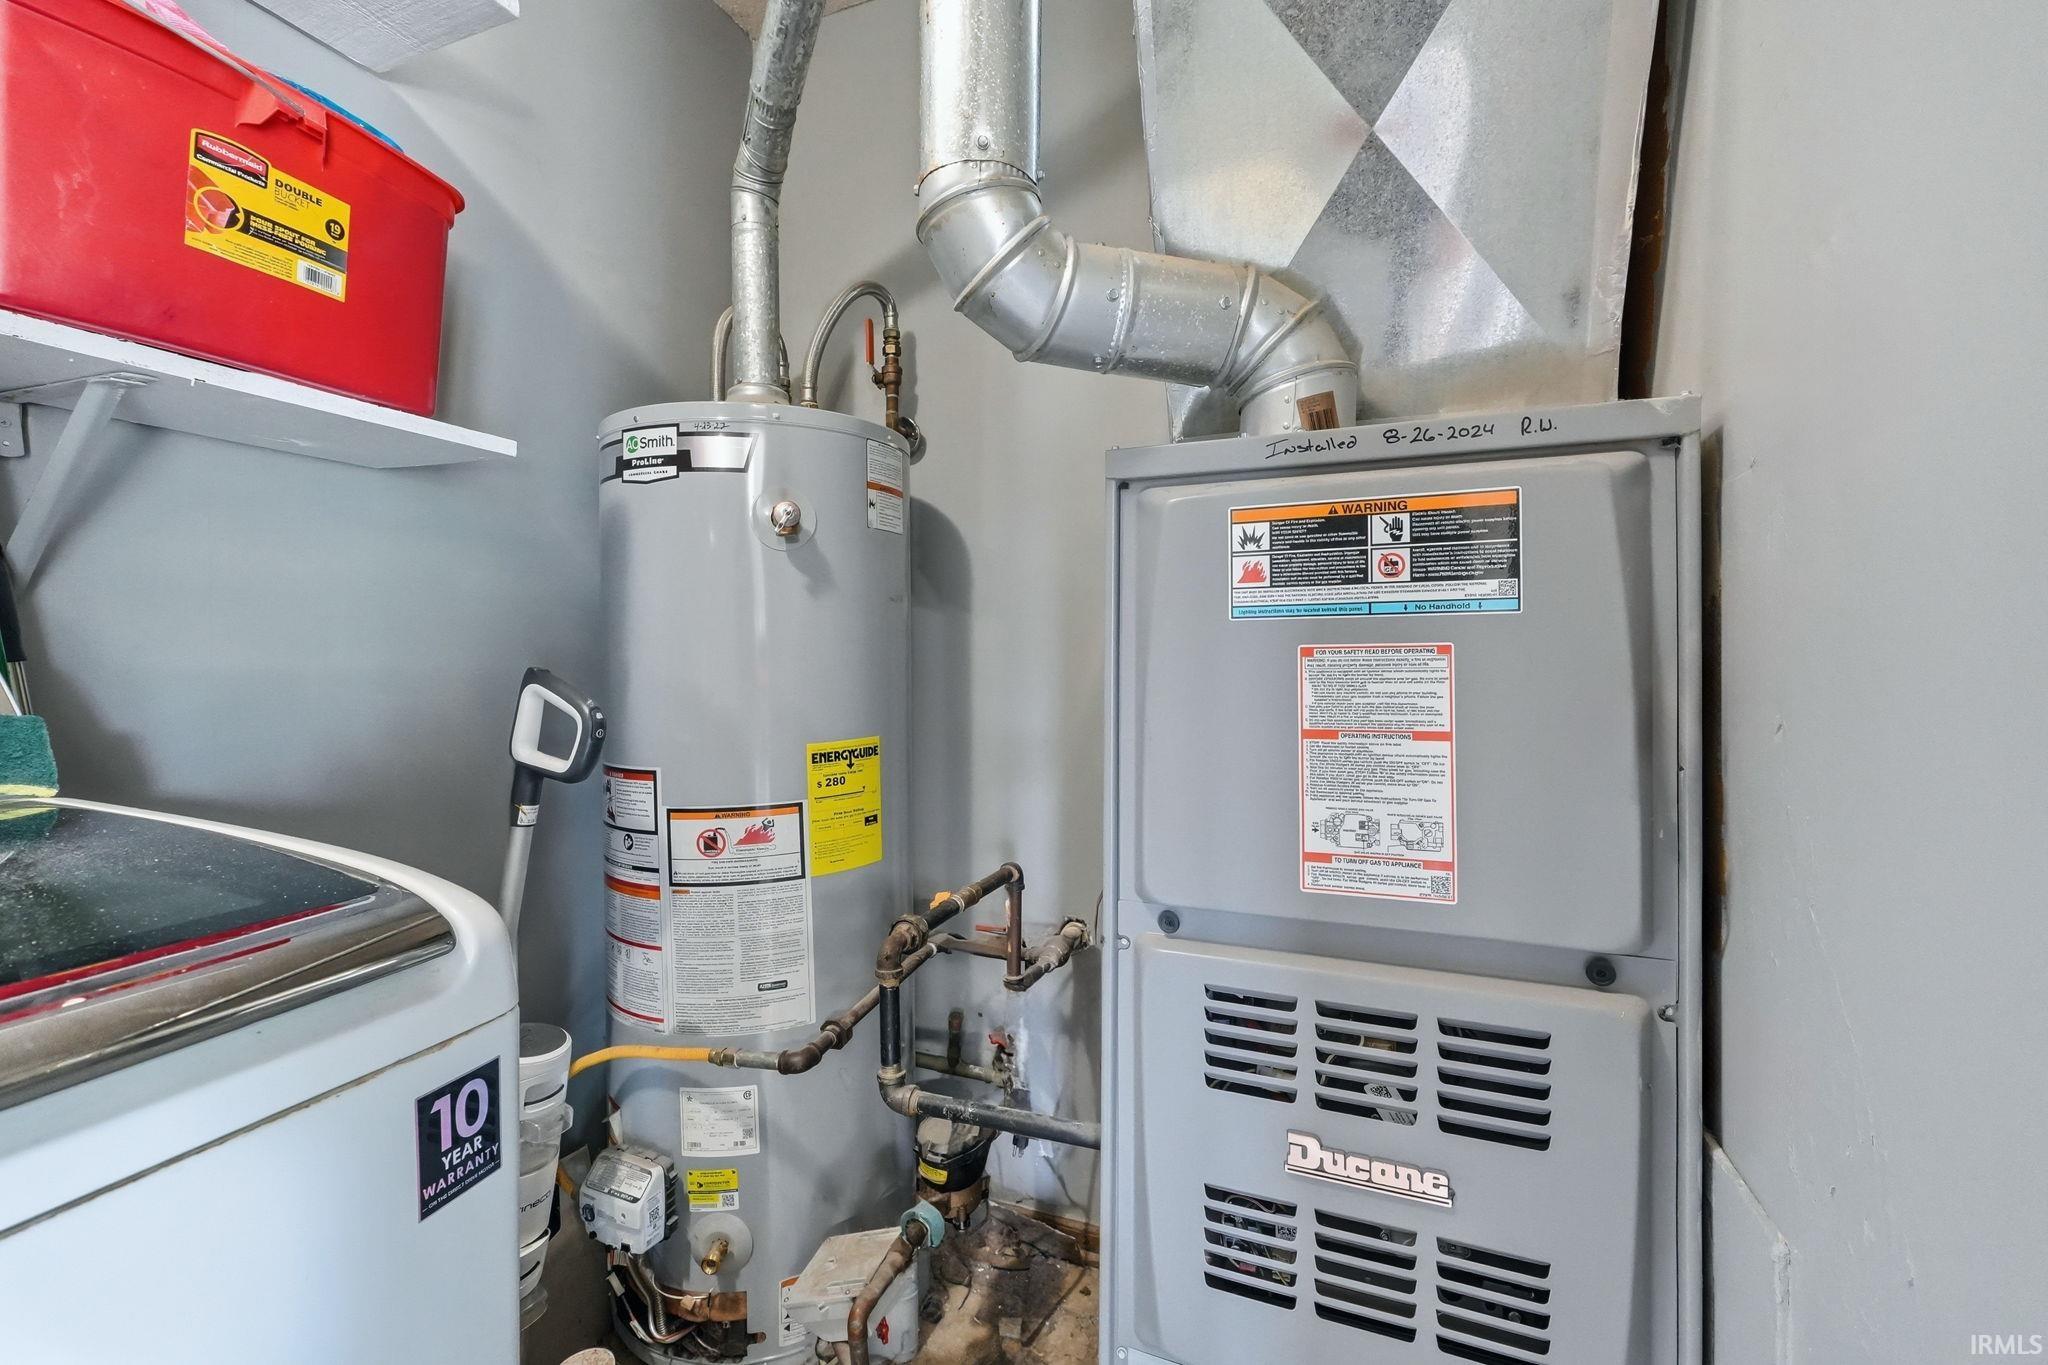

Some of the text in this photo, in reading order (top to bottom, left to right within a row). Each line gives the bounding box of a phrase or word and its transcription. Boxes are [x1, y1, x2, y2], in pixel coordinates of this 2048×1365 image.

[196, 153, 237, 174] Commercial
[202, 140, 262, 171] Rubbermaid
[274, 187, 310, 208] BUCKET
[275, 178, 323, 207] DOUBLE
[329, 223, 341, 235] 19
[640, 435, 673, 449] Smith
[1265, 416, 1558, 459] Installed 8-26-2024 R.W.
[631, 457, 664, 467] ProLine
[1342, 500, 1408, 514] WARNING
[1428, 602, 1470, 610] Handhold
[811, 745, 879, 767] ENERGYGUIDE
[825, 776, 846, 787] 280
[1391, 861, 1422, 869] APPLIANCE
[430, 1078, 489, 1152] 10
[441, 1135, 482, 1171] YEAR
[423, 1142, 499, 1201] WARRANTY
[1287, 1129, 1450, 1199] Ducane
